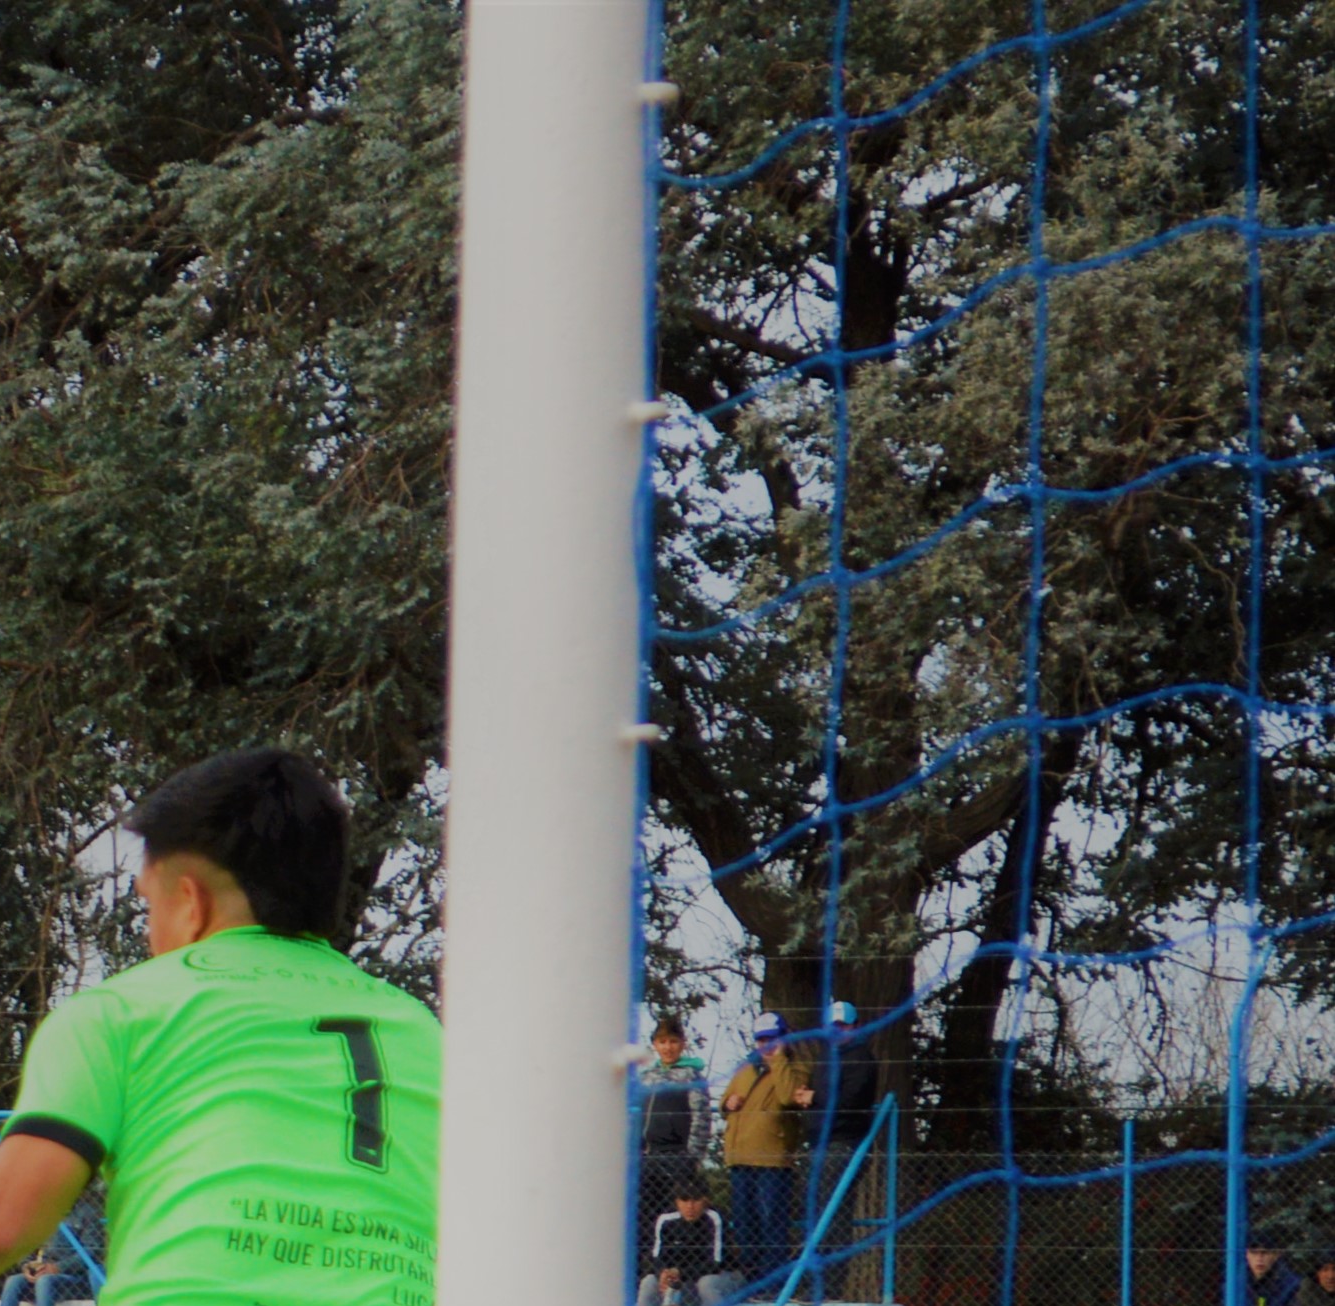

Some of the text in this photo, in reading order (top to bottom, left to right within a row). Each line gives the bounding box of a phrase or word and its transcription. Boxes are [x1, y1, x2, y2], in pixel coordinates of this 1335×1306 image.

[312, 1016, 389, 1174] 1
[275, 1202, 325, 1230] VIDA
[331, 1210, 357, 1235] ES
[360, 1217, 400, 1245] UNA
[226, 1229, 270, 1257] HAY
[272, 1238, 316, 1267] QUE
